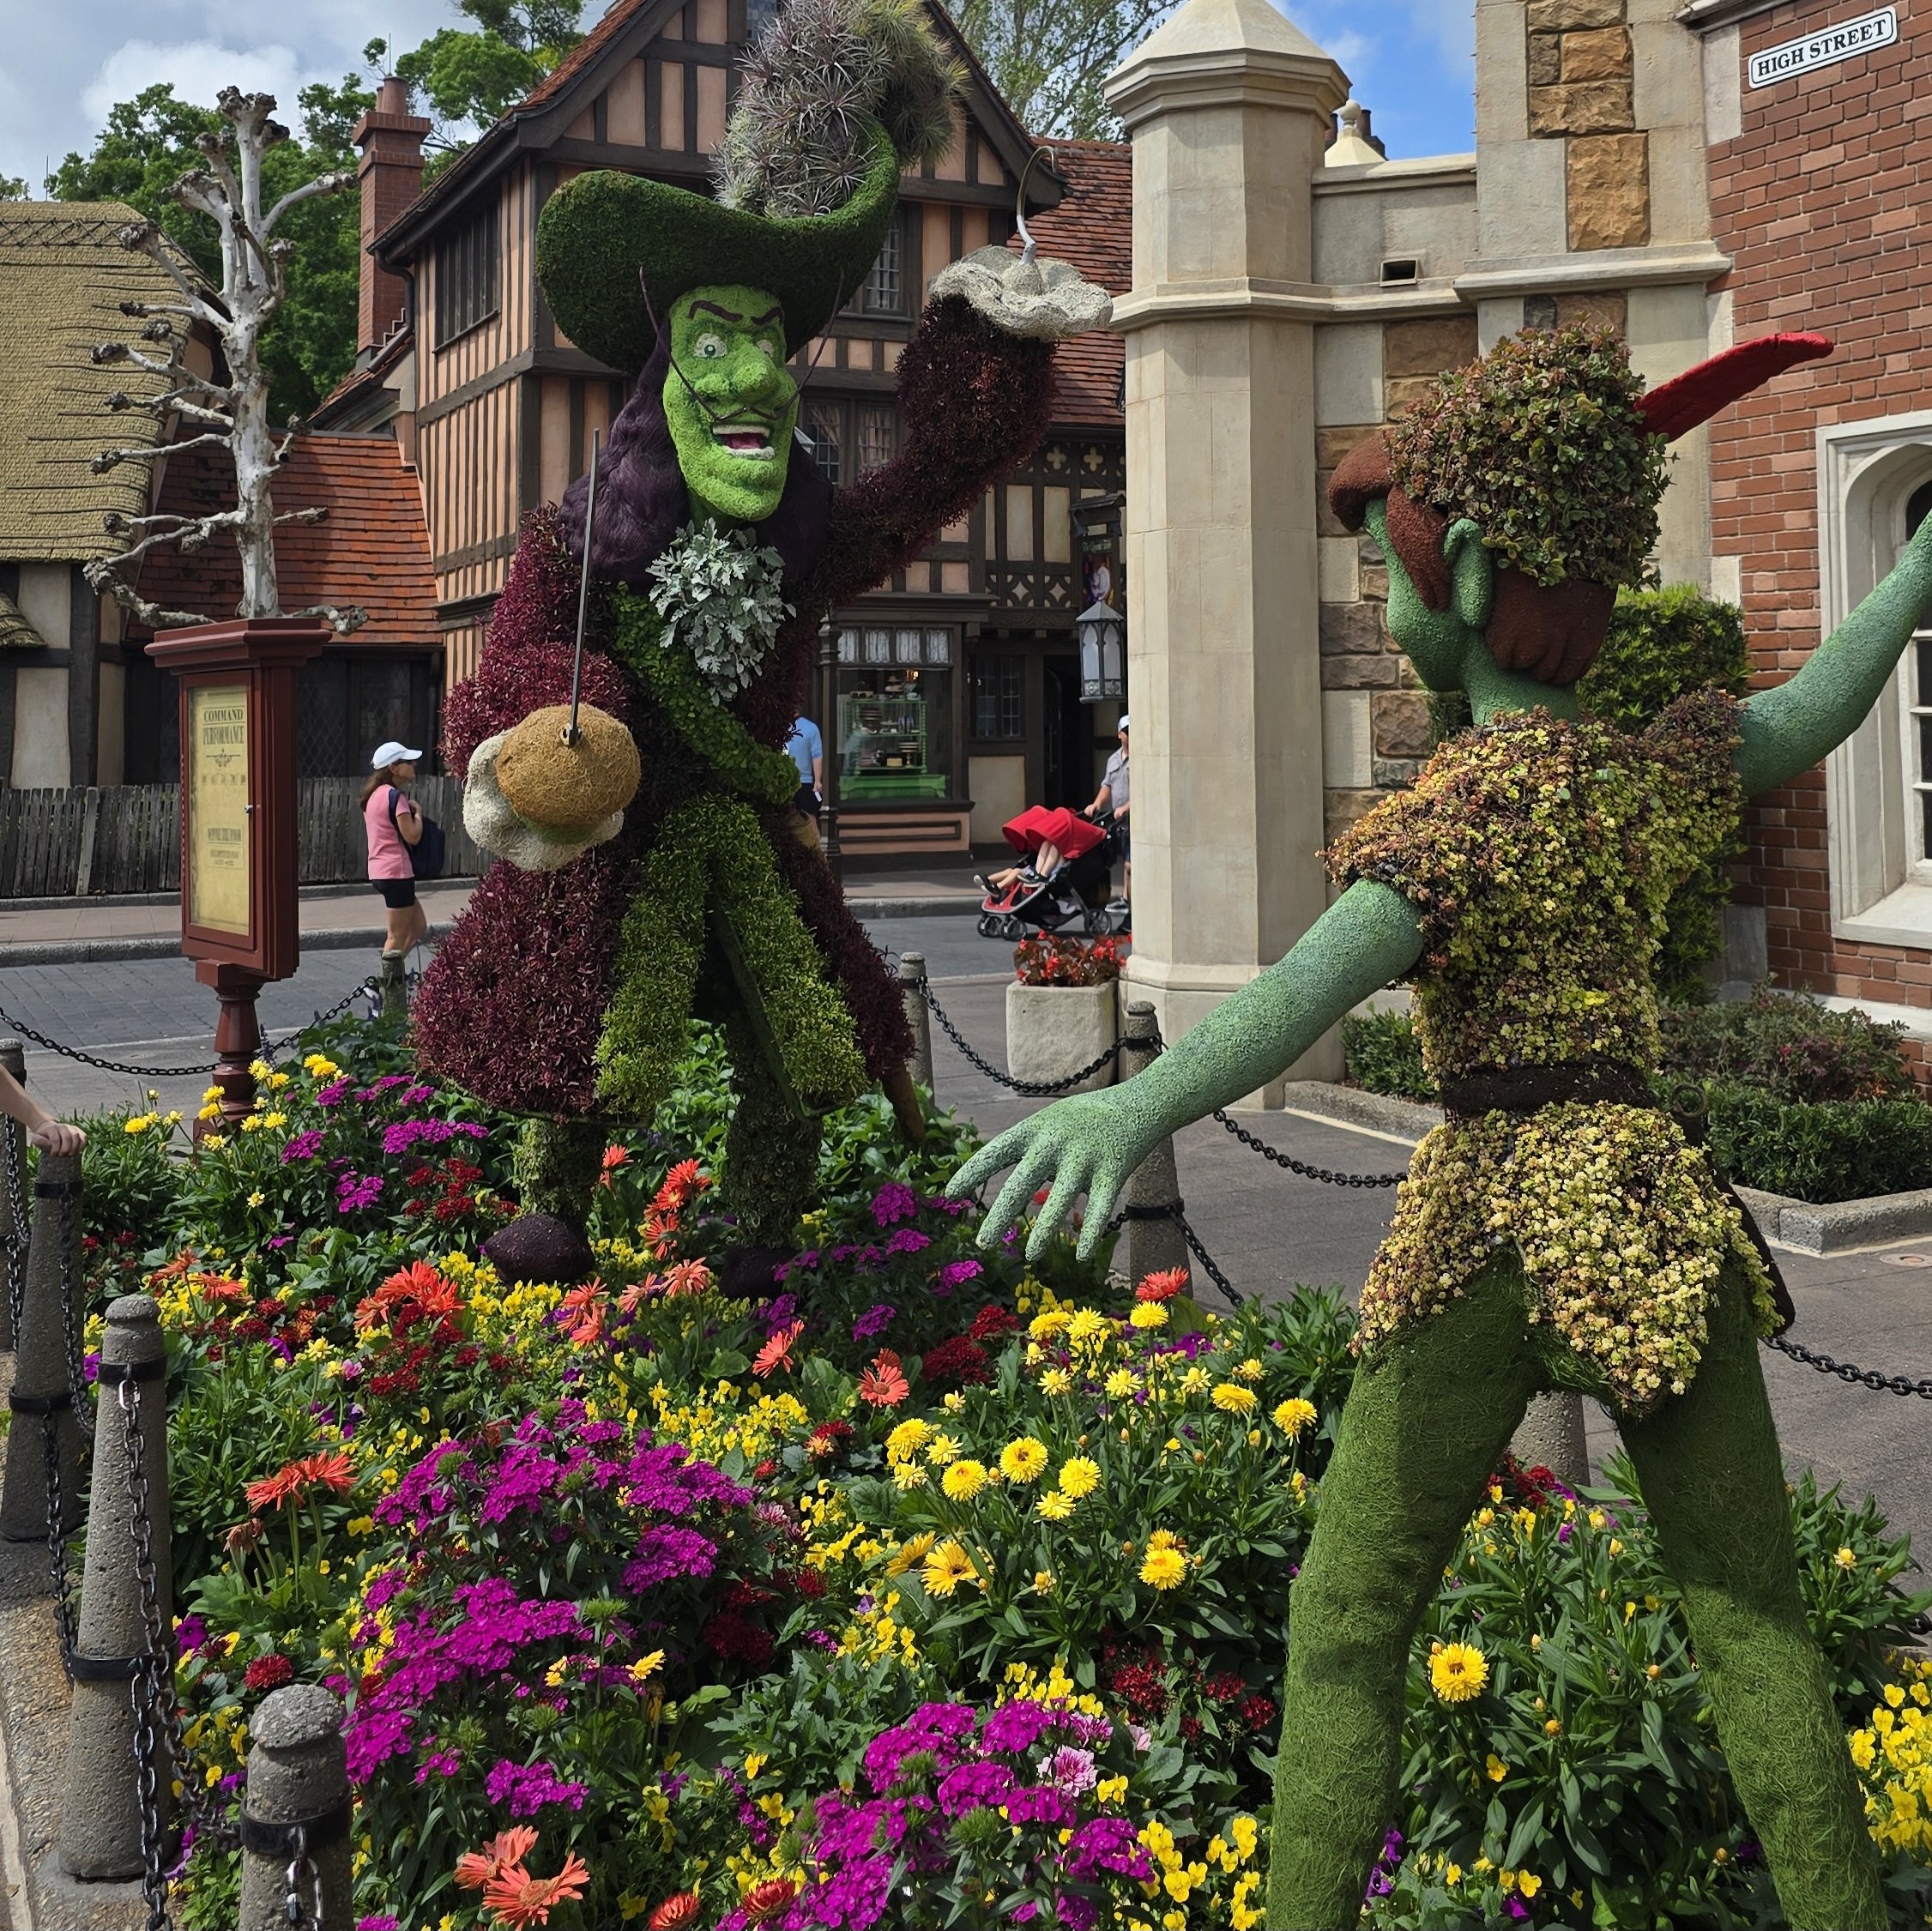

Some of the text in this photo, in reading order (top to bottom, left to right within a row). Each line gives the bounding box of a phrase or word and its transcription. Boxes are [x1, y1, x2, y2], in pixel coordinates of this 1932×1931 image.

[1757, 19, 1887, 77] HIGH STREET
[203, 709, 244, 722] COMMAND
[202, 726, 245, 745] PERFORMANCE
